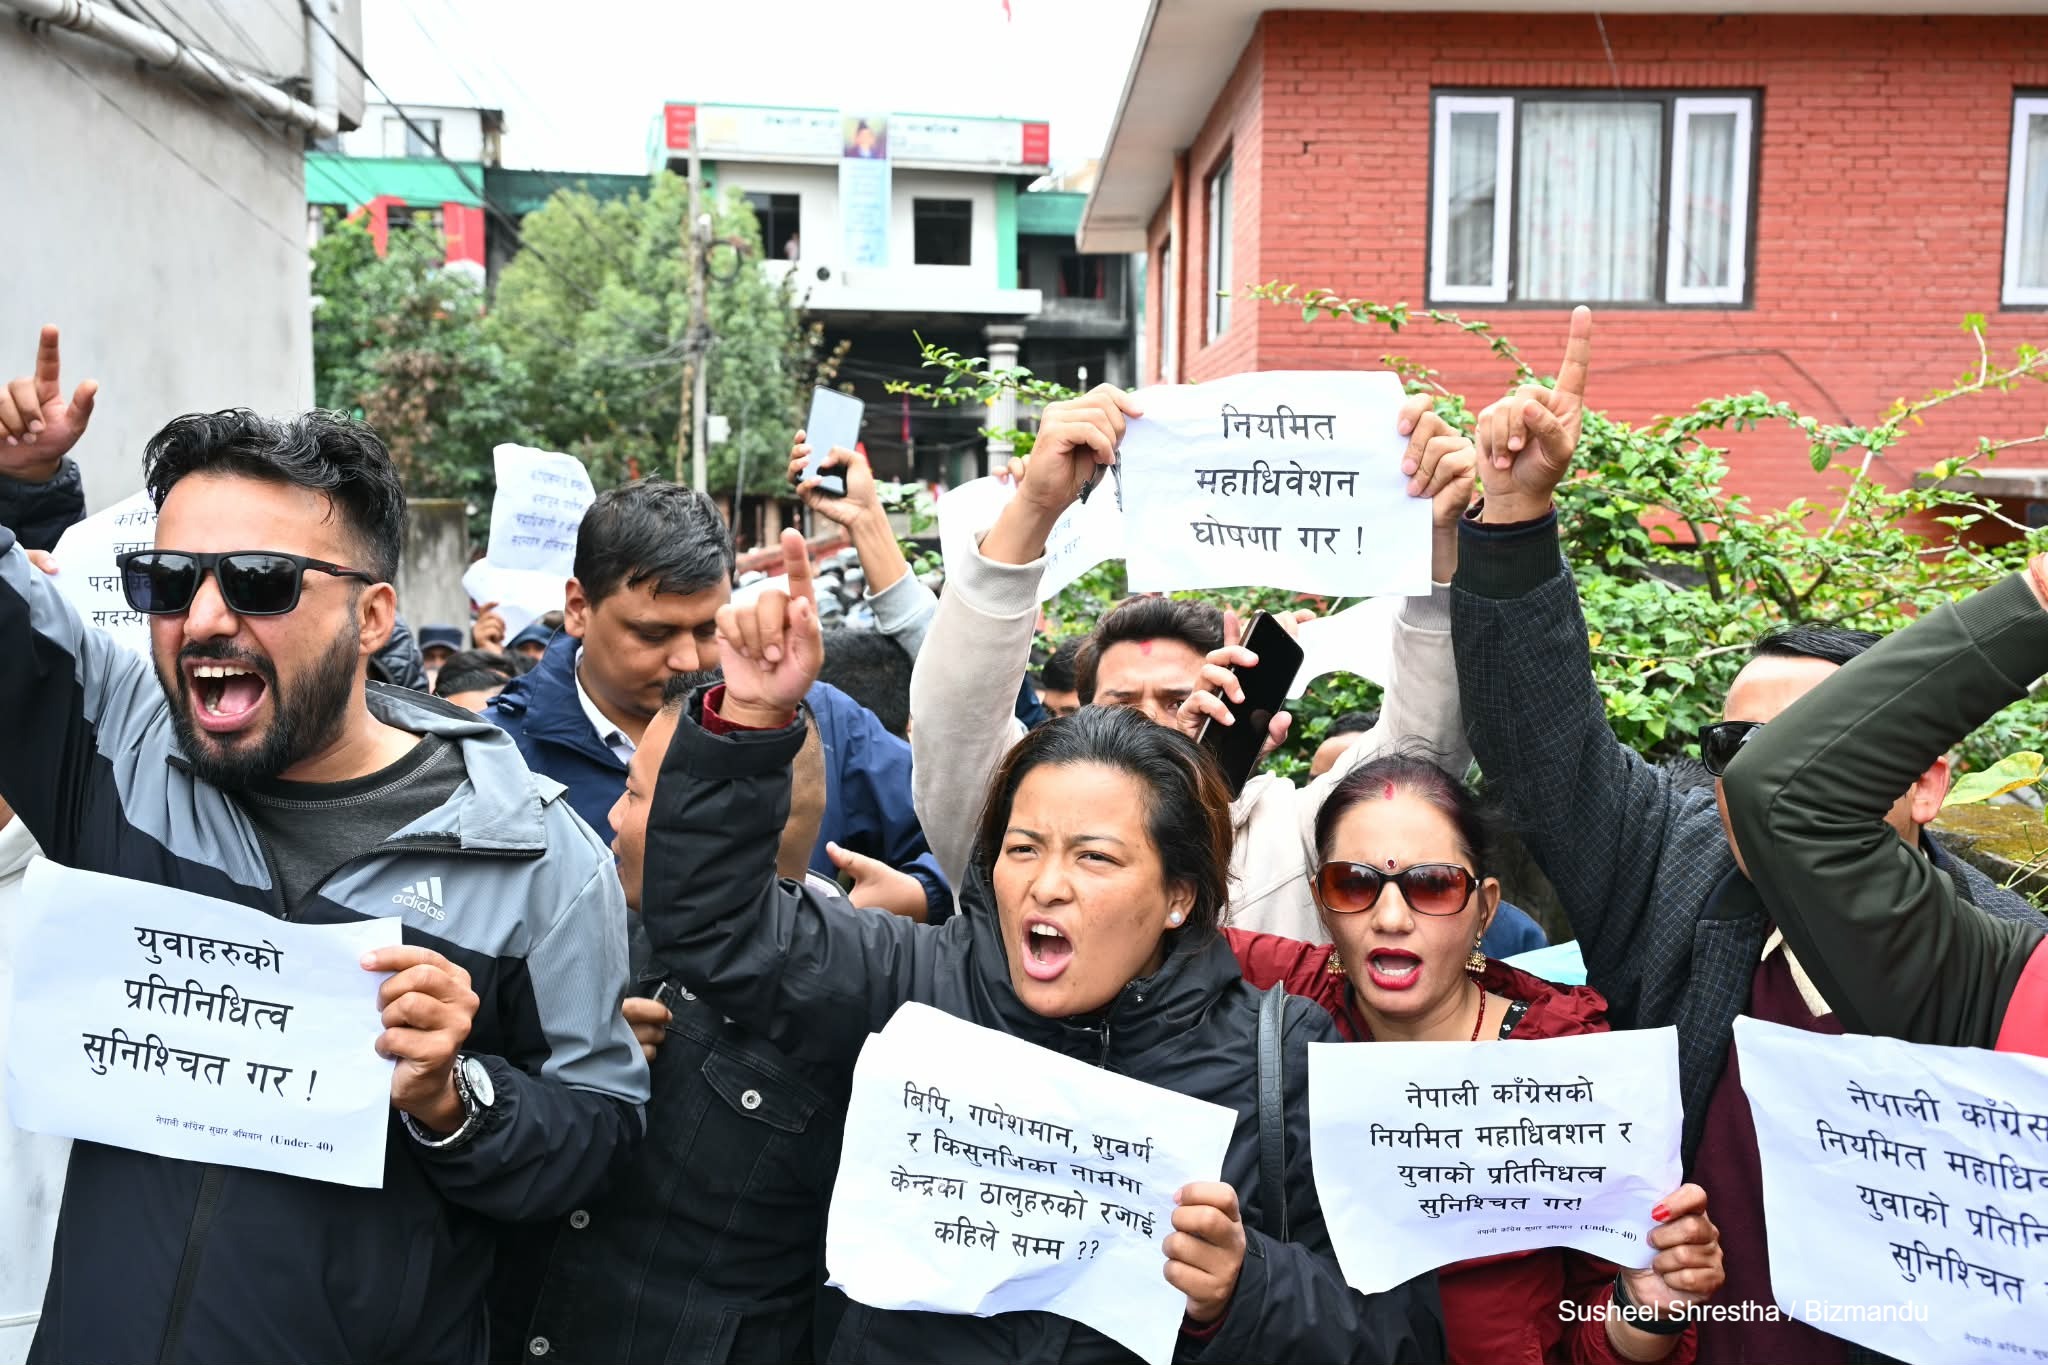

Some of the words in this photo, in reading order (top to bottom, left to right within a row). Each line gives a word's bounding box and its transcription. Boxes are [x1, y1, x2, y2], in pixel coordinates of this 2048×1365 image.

[1221, 404, 1336, 440] नियमित
[1195, 460, 1359, 497] महाधिवेशन
[1190, 514, 1282, 552] घोषणा
[1297, 528, 1340, 554] गर
[1357, 526, 1362, 555] !
[392, 894, 445, 920] adidas
[134, 927, 284, 974] युवाहरुको
[124, 973, 294, 1033] प्रतिनिधित्व
[82, 1028, 230, 1086] सुनिश्चित
[246, 1061, 293, 1097] गर
[306, 1070, 317, 1102] !
[1405, 1080, 1480, 1109] नेपाली
[1491, 1075, 1594, 1104] काँग्रेसको
[1847, 1080, 1940, 1123] नेपाली
[156, 1115, 179, 1127] नेपाली
[316, 1141, 334, 1153] 40)
[904, 1081, 953, 1124] बिपि,
[968, 1103, 1077, 1154] गणेशमान,
[1370, 1123, 1463, 1149] नियमित
[1475, 1117, 1606, 1147] महाधिवशन
[1618, 1122, 1632, 1143] र
[907, 1133, 921, 1152] र
[934, 1128, 1058, 1175] किसुनजिका
[1070, 1164, 1143, 1195] नाममा
[1816, 1119, 1927, 1171] नियमित
[1397, 1162, 1475, 1188] युवाको
[890, 1165, 968, 1200] केन्द्रका
[980, 1182, 1088, 1220] ठालुहरुको
[1100, 1202, 1156, 1239] रजाई
[1418, 1193, 1530, 1218] सुनिश्चित
[1856, 1185, 1950, 1228] युवाको
[934, 1216, 1000, 1251] कहिले
[1012, 1233, 1065, 1260] सम्म
[1077, 1240, 1099, 1260] ??
[1889, 1240, 2025, 1304] सुनिश्चित
